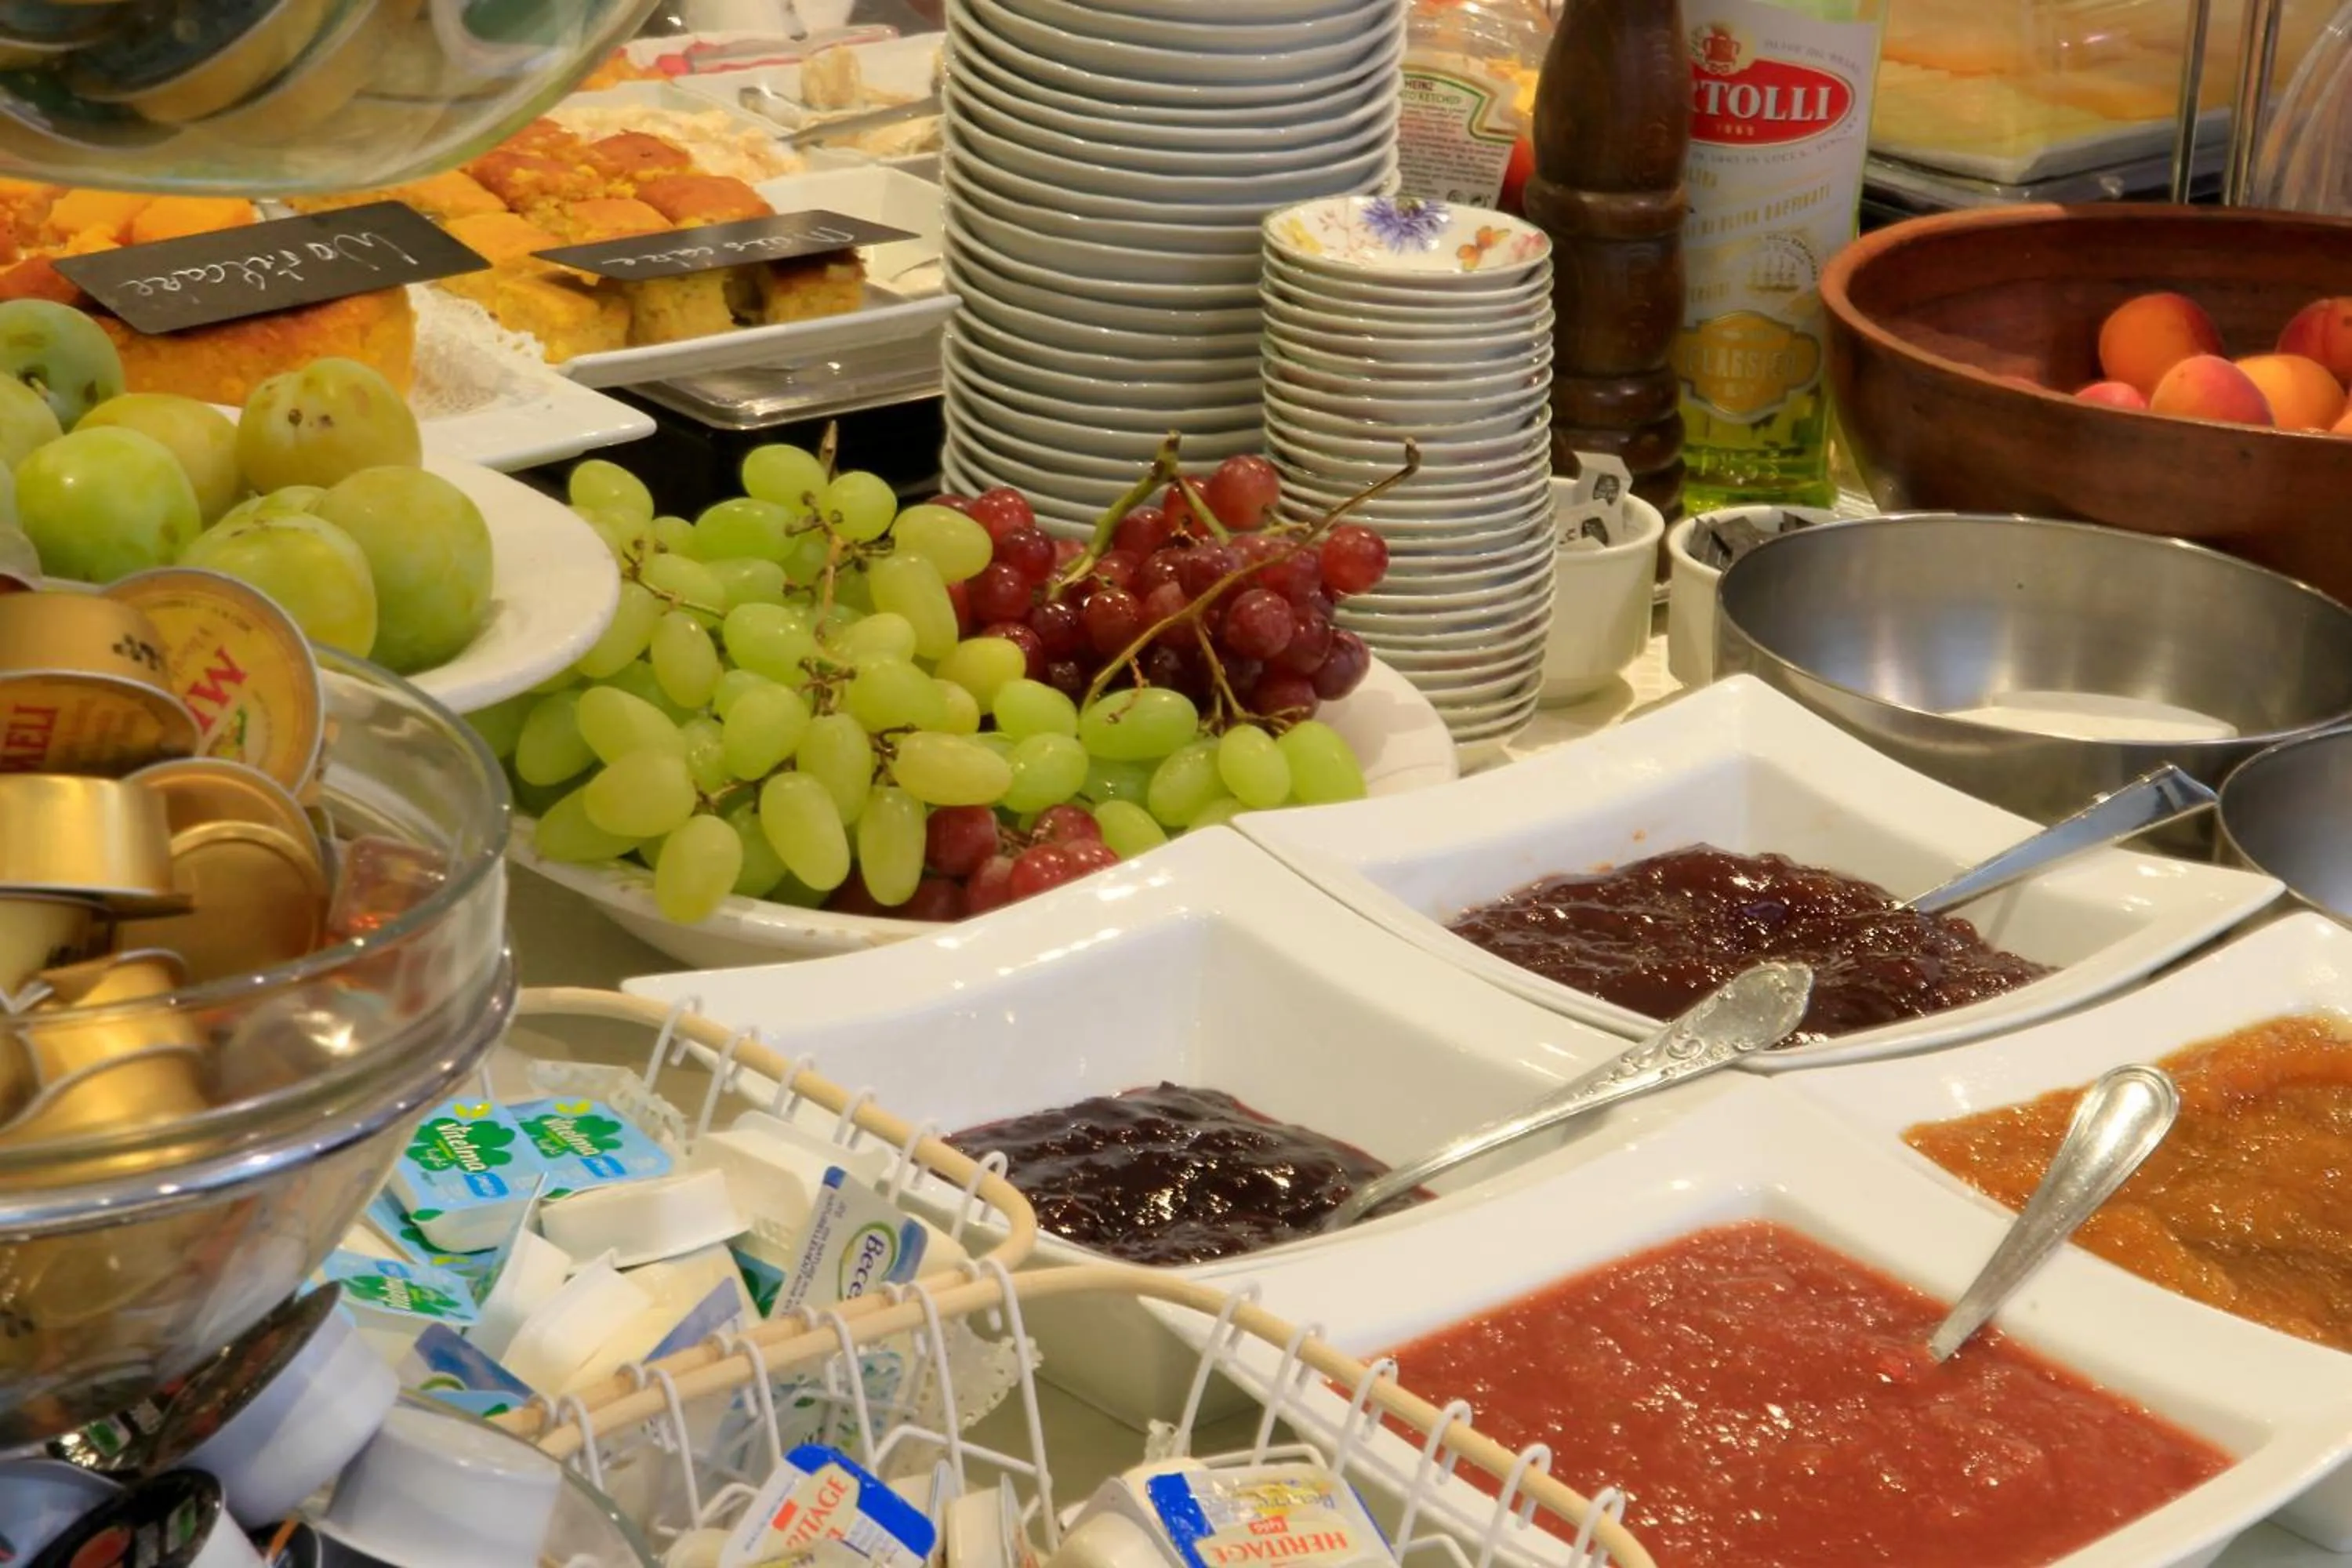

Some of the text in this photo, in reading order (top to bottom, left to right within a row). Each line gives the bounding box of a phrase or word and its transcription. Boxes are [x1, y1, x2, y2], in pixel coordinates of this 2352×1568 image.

[435, 1123, 487, 1172] Vitelma
[846, 1234, 885, 1301] Bece
[1210, 1531, 1348, 1564] HERITAGE
